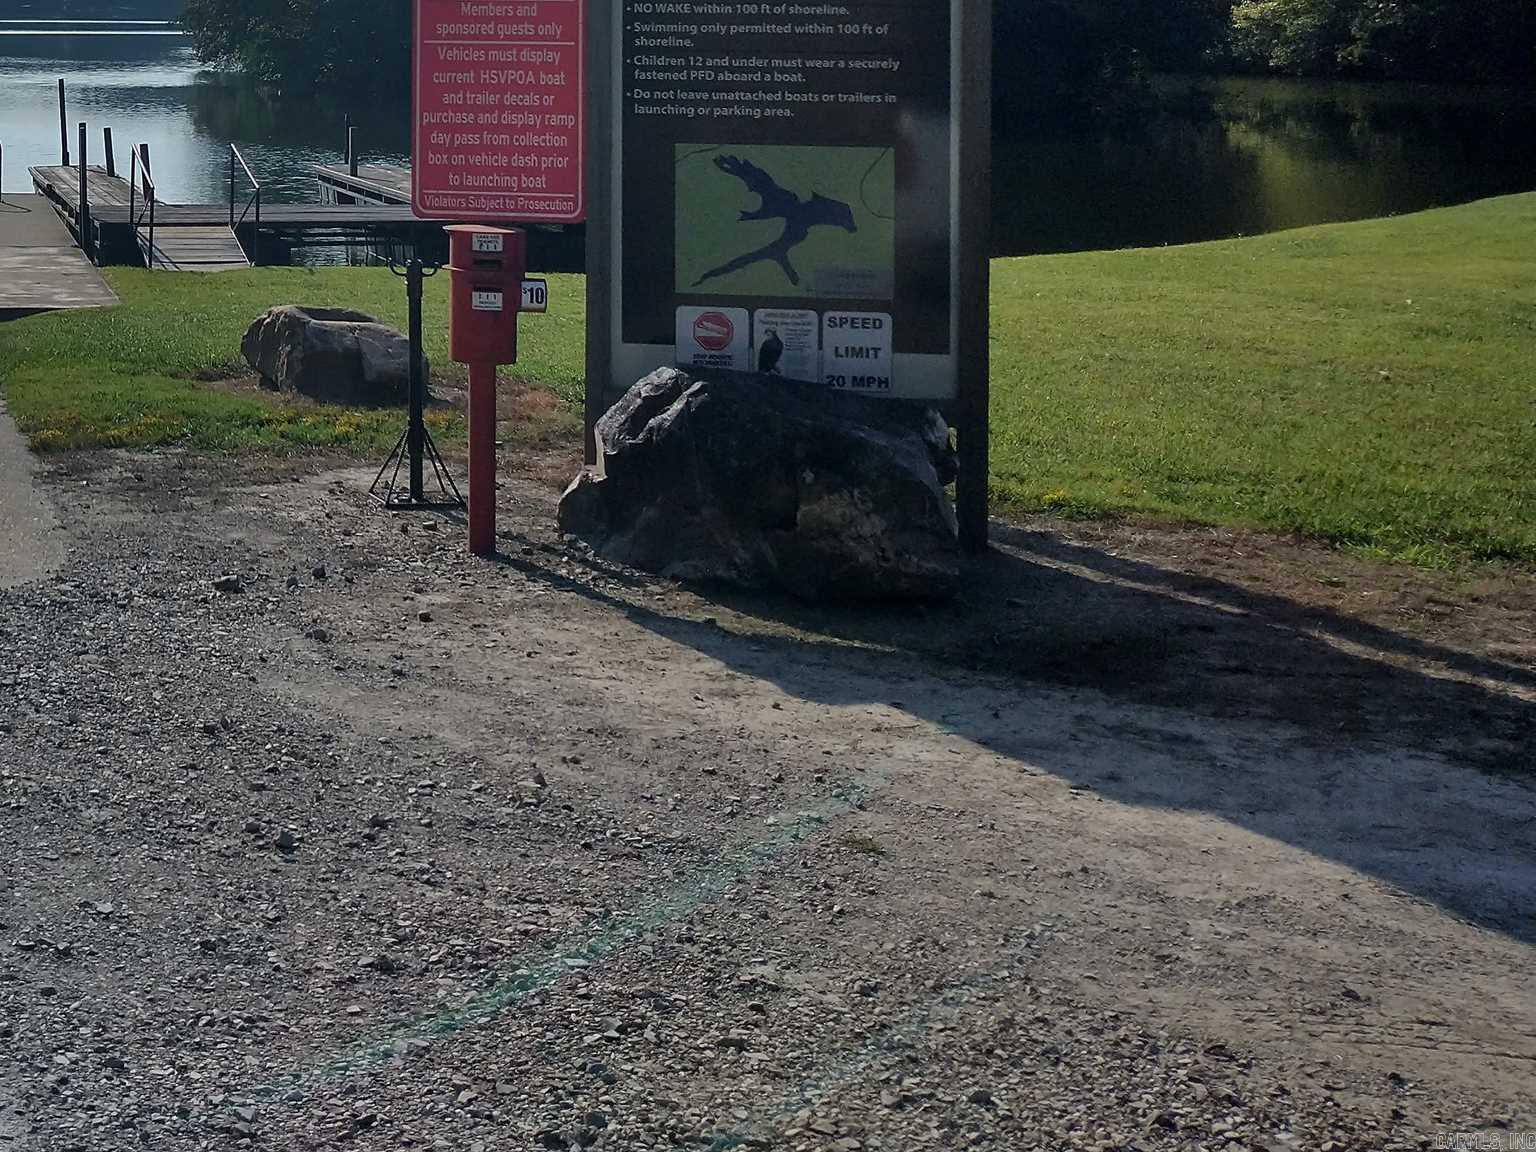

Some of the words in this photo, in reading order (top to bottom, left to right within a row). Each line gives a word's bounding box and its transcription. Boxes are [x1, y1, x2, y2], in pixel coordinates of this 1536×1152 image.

[461, 1, 513, 16] Members
[516, 2, 537, 17] and
[634, 4, 652, 14] NO
[656, 4, 691, 14] WAKE
[694, 4, 732, 14] within
[736, 4, 758, 14] 100
[788, 5, 849, 15] shoreline.
[436, 21, 495, 38] sponsored
[497, 23, 535, 39] guests
[537, 22, 563, 40] only
[634, 23, 697, 35] Swimming
[700, 23, 728, 36] only
[732, 23, 791, 36] permitted
[794, 24, 833, 33] within
[837, 24, 860, 34] 100
[634, 37, 694, 47] shoreline.
[438, 47, 485, 61] Vehicles
[488, 49, 517, 62] must
[520, 47, 561, 66] display
[634, 56, 684, 65] Children
[688, 56, 703, 66] 12
[706, 56, 728, 66] and
[733, 57, 769, 67] under
[772, 57, 802, 67] must
[848, 58, 900, 71] securely
[433, 71, 474, 84] current
[480, 70, 534, 85] HSVPOA
[539, 71, 565, 86] boat
[634, 70, 687, 80] fastened
[690, 70, 714, 80] PFD
[718, 71, 761, 81] aboard
[774, 72, 806, 82] boat.
[443, 91, 463, 105] and
[466, 91, 500, 105] trailer
[503, 91, 539, 106] decals
[542, 94, 555, 106] or
[634, 89, 650, 99] Do
[654, 89, 674, 99] not
[677, 89, 709, 100] leave
[712, 90, 781, 100] unattached
[784, 91, 819, 101] boats
[838, 92, 882, 102] trailers
[424, 109, 475, 125] purchase
[477, 110, 498, 125] and
[501, 111, 542, 129] display
[545, 114, 575, 129] ramp
[634, 105, 694, 118] launching
[714, 106, 761, 119] parking
[764, 109, 794, 117] area.
[431, 131, 451, 147] day
[454, 134, 480, 147] pass
[484, 131, 510, 145] from
[513, 132, 568, 147] collection
[428, 151, 448, 165] box
[451, 154, 465, 166] on
[469, 152, 508, 167] vehicle
[511, 153, 537, 168] dash
[541, 154, 569, 171] prior
[448, 173, 460, 186] to
[464, 172, 518, 190] launching
[521, 174, 547, 189] boat
[424, 195, 465, 208] Violators
[468, 196, 504, 211] Subject
[506, 199, 514, 210] to
[518, 198, 574, 212] Prosecution
[827, 317, 883, 329] SPEED
[835, 346, 882, 359] LIMIT
[827, 375, 846, 388] 20
[851, 376, 889, 389] MPH
